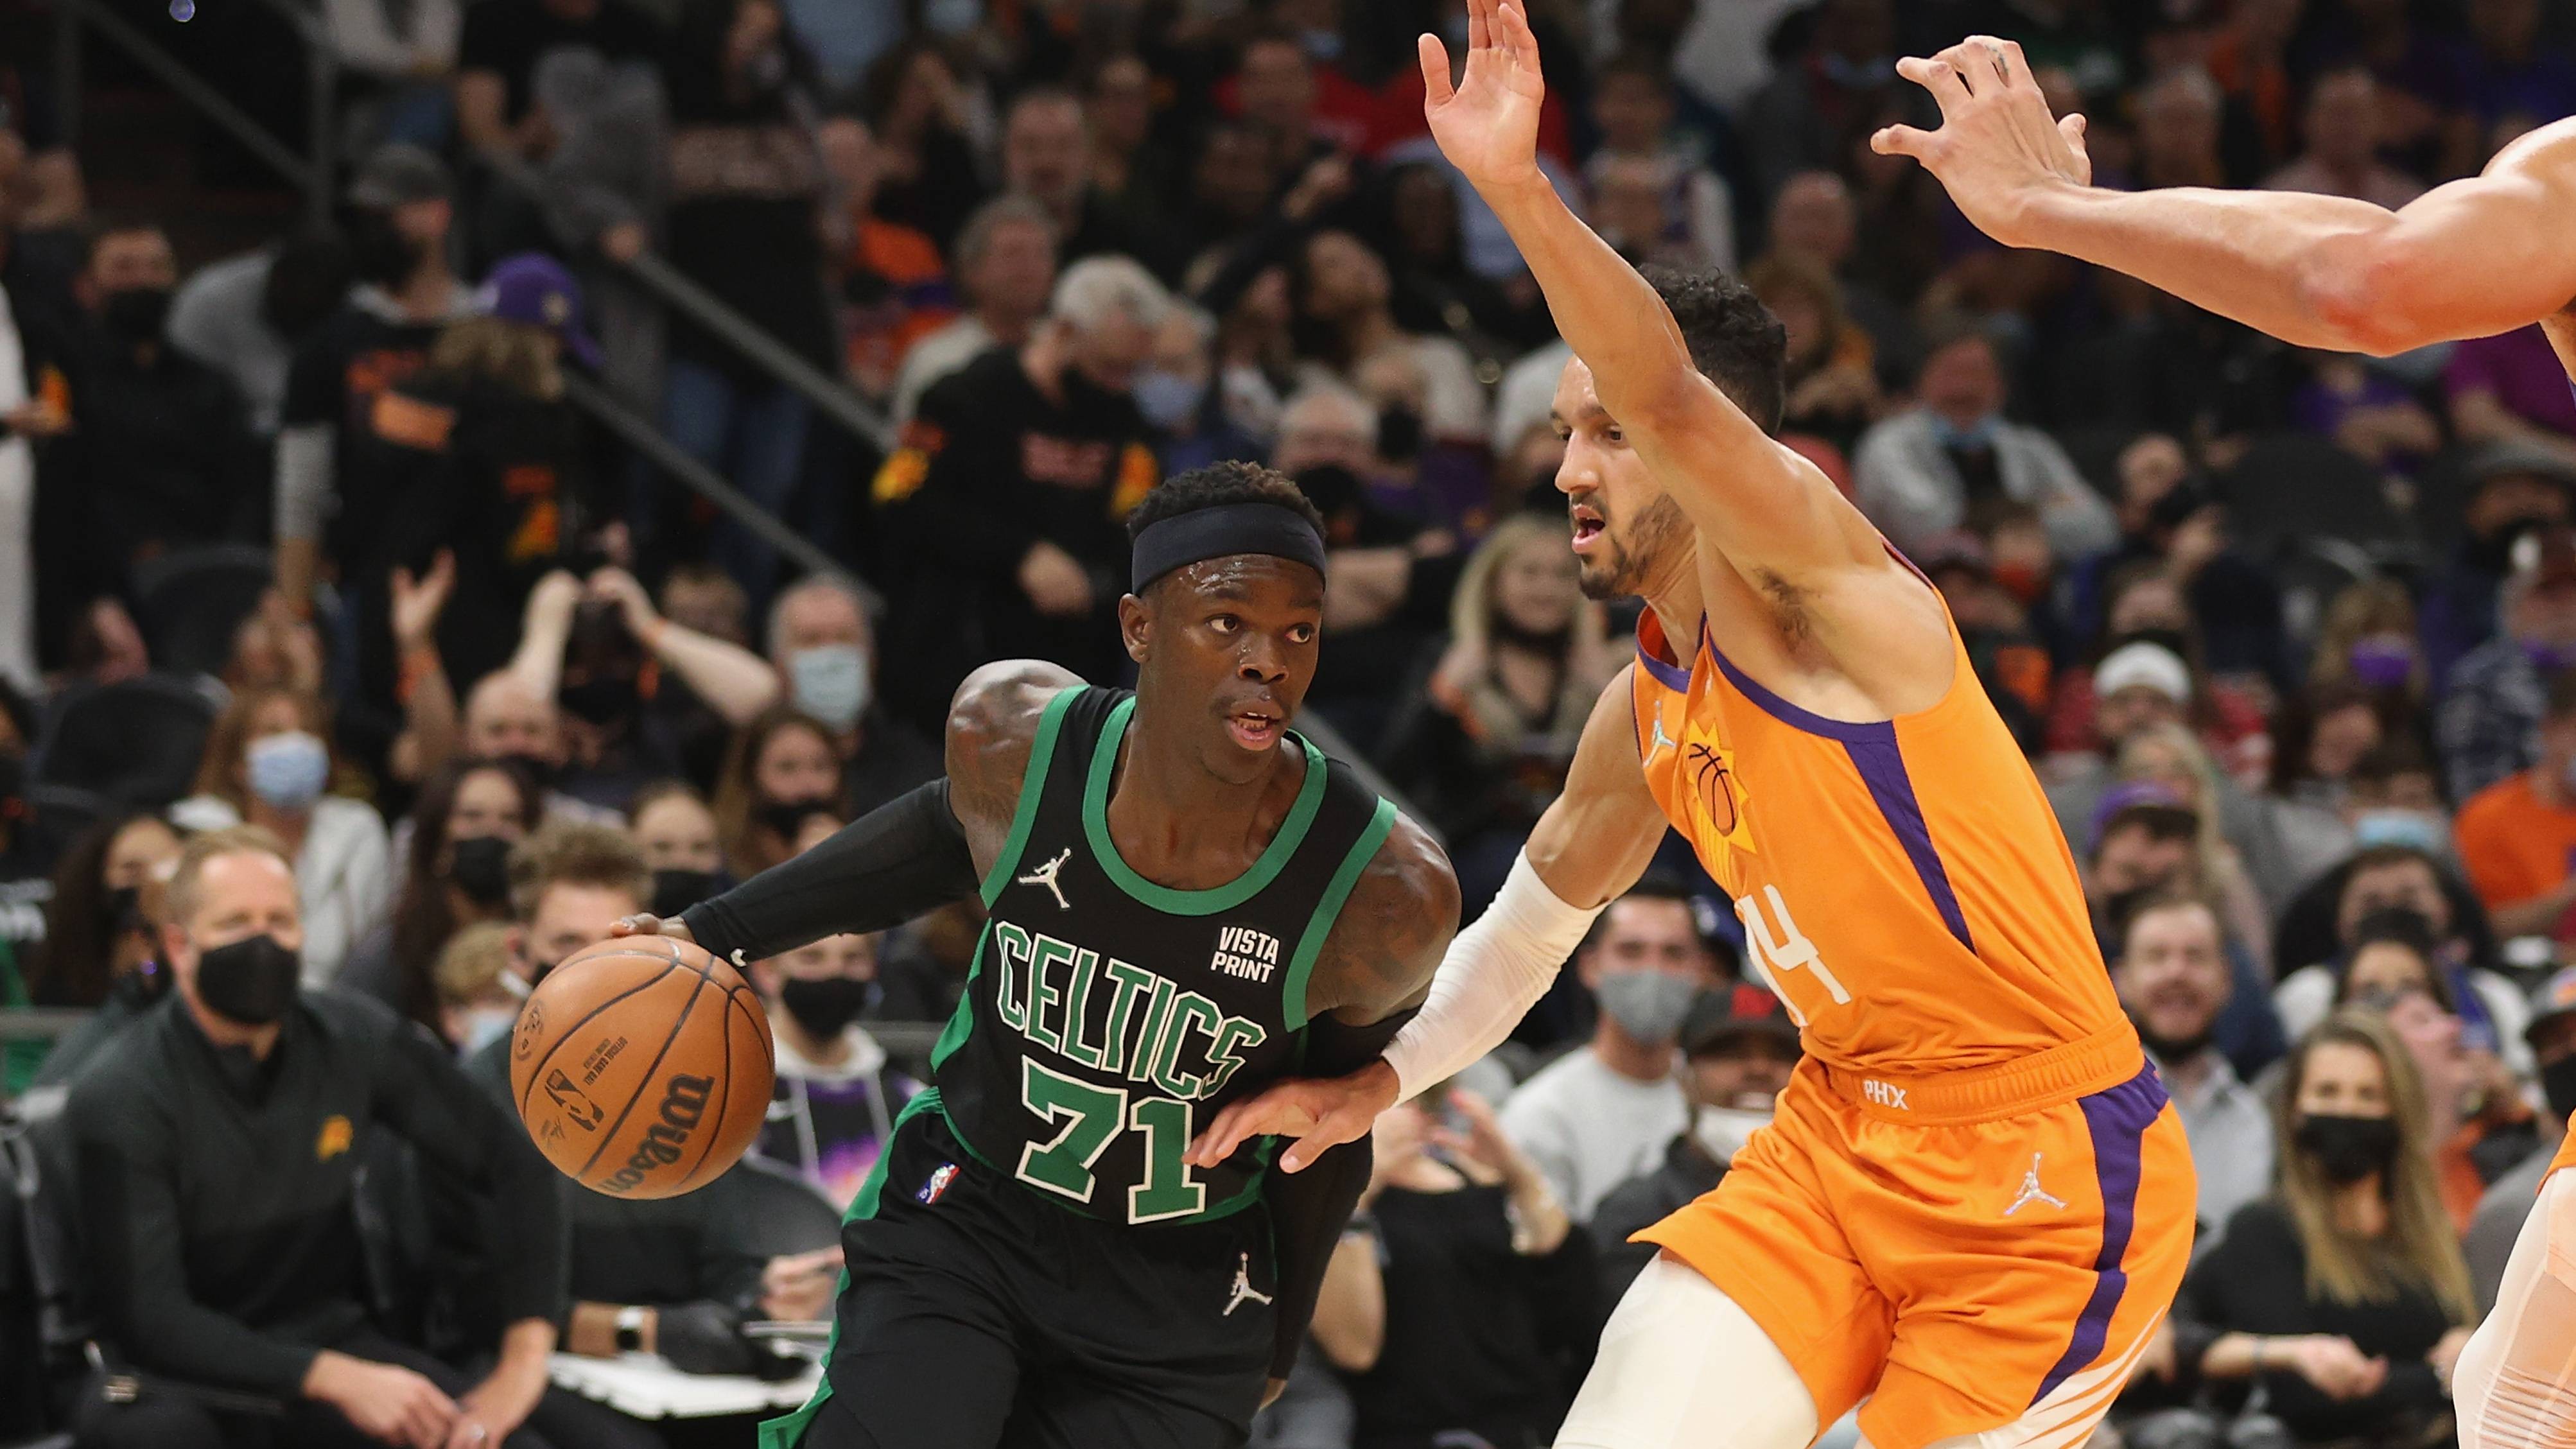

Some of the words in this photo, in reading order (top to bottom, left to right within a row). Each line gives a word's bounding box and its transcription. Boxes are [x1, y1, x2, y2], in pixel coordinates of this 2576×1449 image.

[1210, 951, 1275, 983] PRINT
[1219, 926, 1280, 965] VISTA
[996, 921, 1267, 1100] CELTICS
[597, 1073, 716, 1193] Wilson
[1863, 1079, 1910, 1111] PHX
[1014, 1055, 1206, 1224] 71
